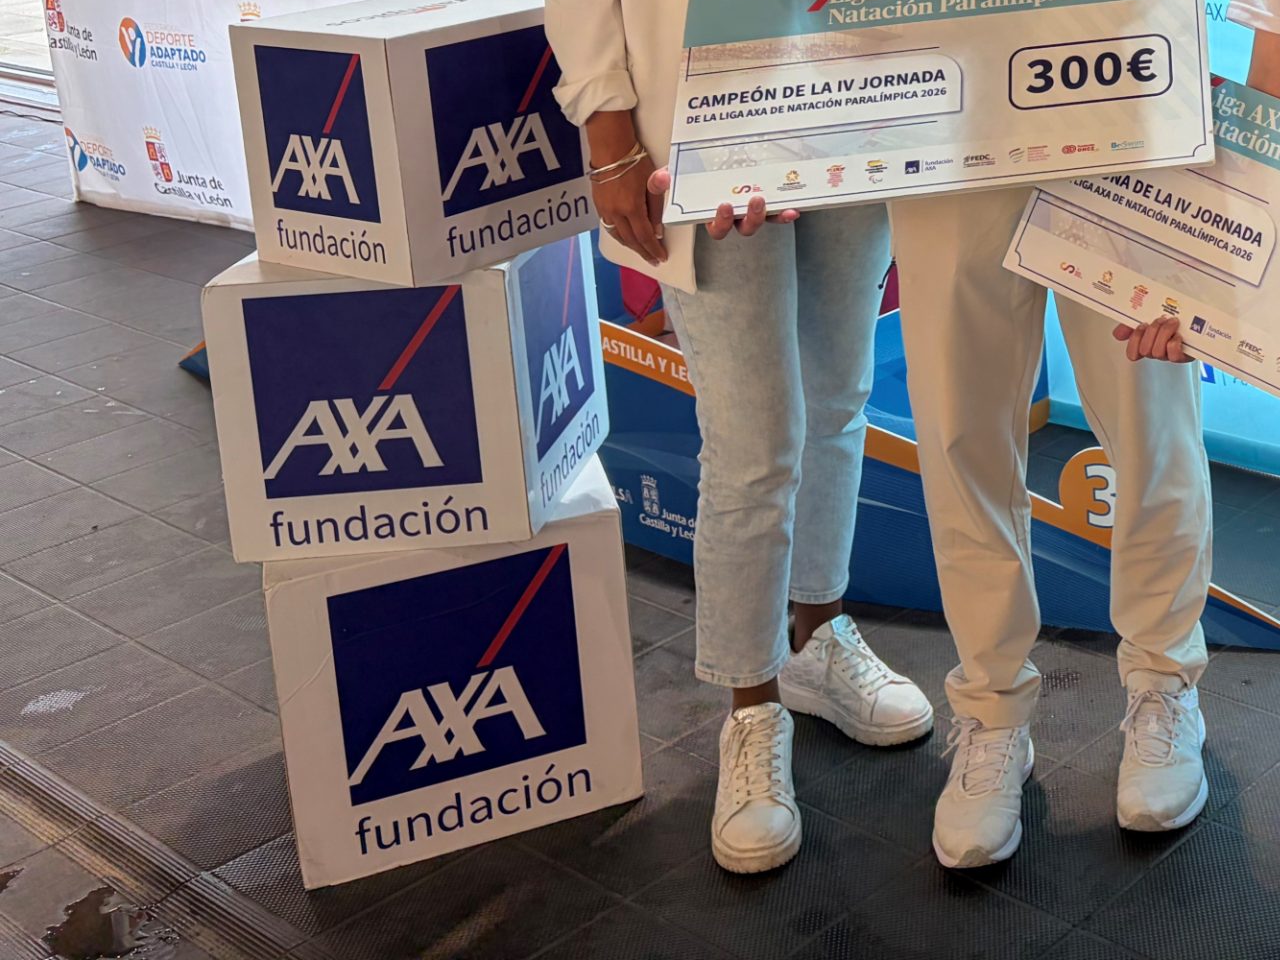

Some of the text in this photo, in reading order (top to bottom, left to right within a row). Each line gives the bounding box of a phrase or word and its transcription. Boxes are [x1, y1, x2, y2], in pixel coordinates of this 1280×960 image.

[828, 0, 932, 24] Natación
[146, 31, 195, 47] DEPORTE
[150, 46, 206, 63] ADAPTADO
[688, 69, 945, 110] CAMPEÓN DE LA IV JORNADA
[1026, 47, 1159, 93] 300€
[686, 87, 947, 125] DE LA LIGA AXA DE NATACIÓN PARALÍMPICA 2026
[1212, 89, 1245, 118] iga
[177, 171, 224, 191] Junta de
[271, 134, 360, 205] AXA
[441, 112, 561, 201] AXA
[447, 191, 589, 258] fundación
[1094, 185, 1112, 198] AXA
[1112, 193, 1125, 205] DE
[1125, 199, 1170, 224] NATACIÓN
[1169, 218, 1229, 252] PARALÍMPICA
[1229, 245, 1254, 261] 2026
[1132, 180, 1151, 198] DE
[1154, 188, 1173, 208] LA
[1175, 197, 1191, 214] IV
[1191, 206, 1263, 248] JORNADA
[277, 218, 386, 265] fundación
[602, 337, 656, 369] ASTILLA
[536, 325, 584, 441] AXA
[264, 393, 445, 480] AXA
[540, 411, 600, 508] fundación
[269, 495, 489, 548] fundación
[662, 508, 687, 526] Junta
[1085, 463, 1116, 530] 3
[349, 665, 547, 786] AXA
[354, 763, 593, 857] fundación
